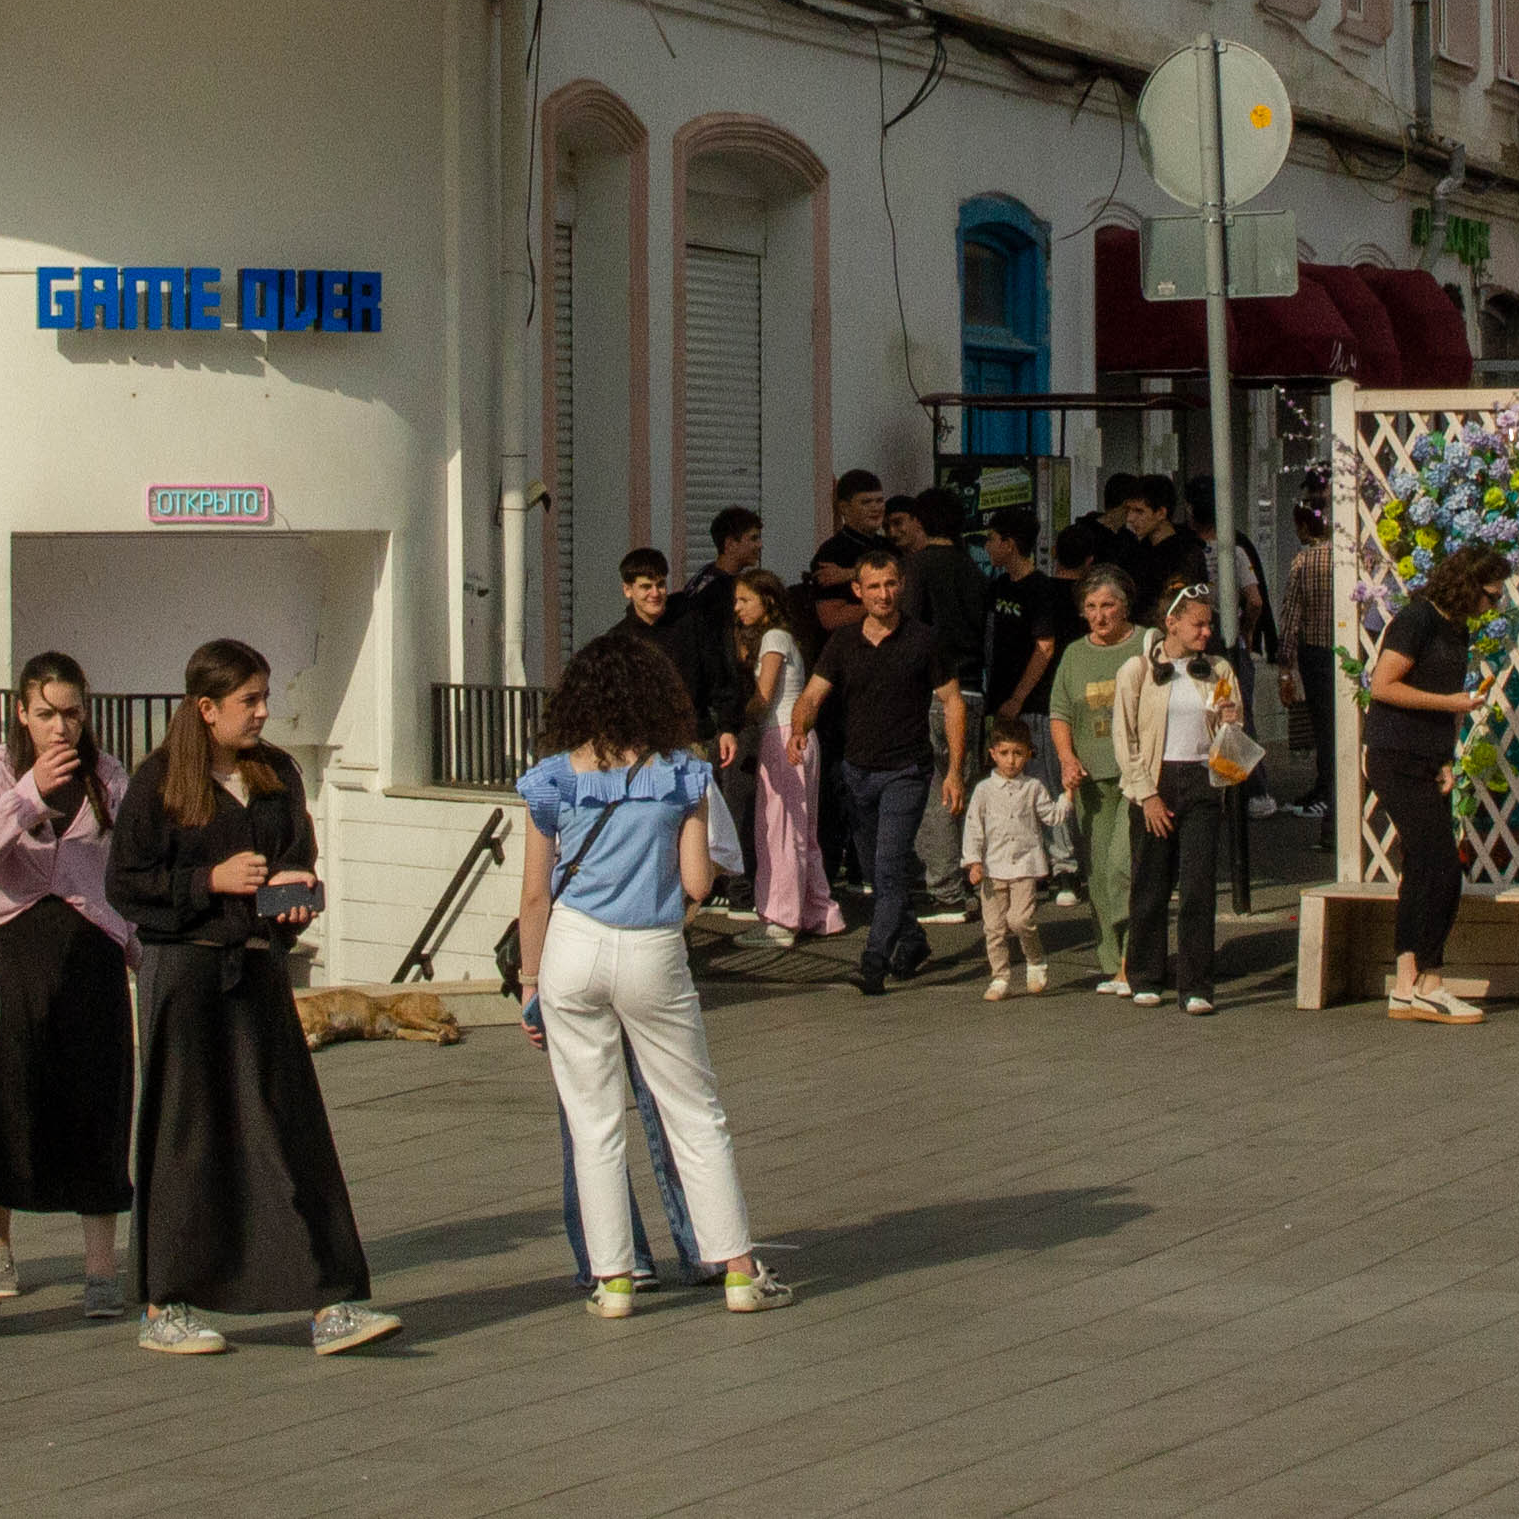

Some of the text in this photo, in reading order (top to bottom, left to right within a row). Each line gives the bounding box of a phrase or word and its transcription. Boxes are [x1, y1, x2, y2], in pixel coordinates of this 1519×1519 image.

[36, 267, 382, 332] GAME OVER
[156, 490, 260, 515] ОТКРЫТО
